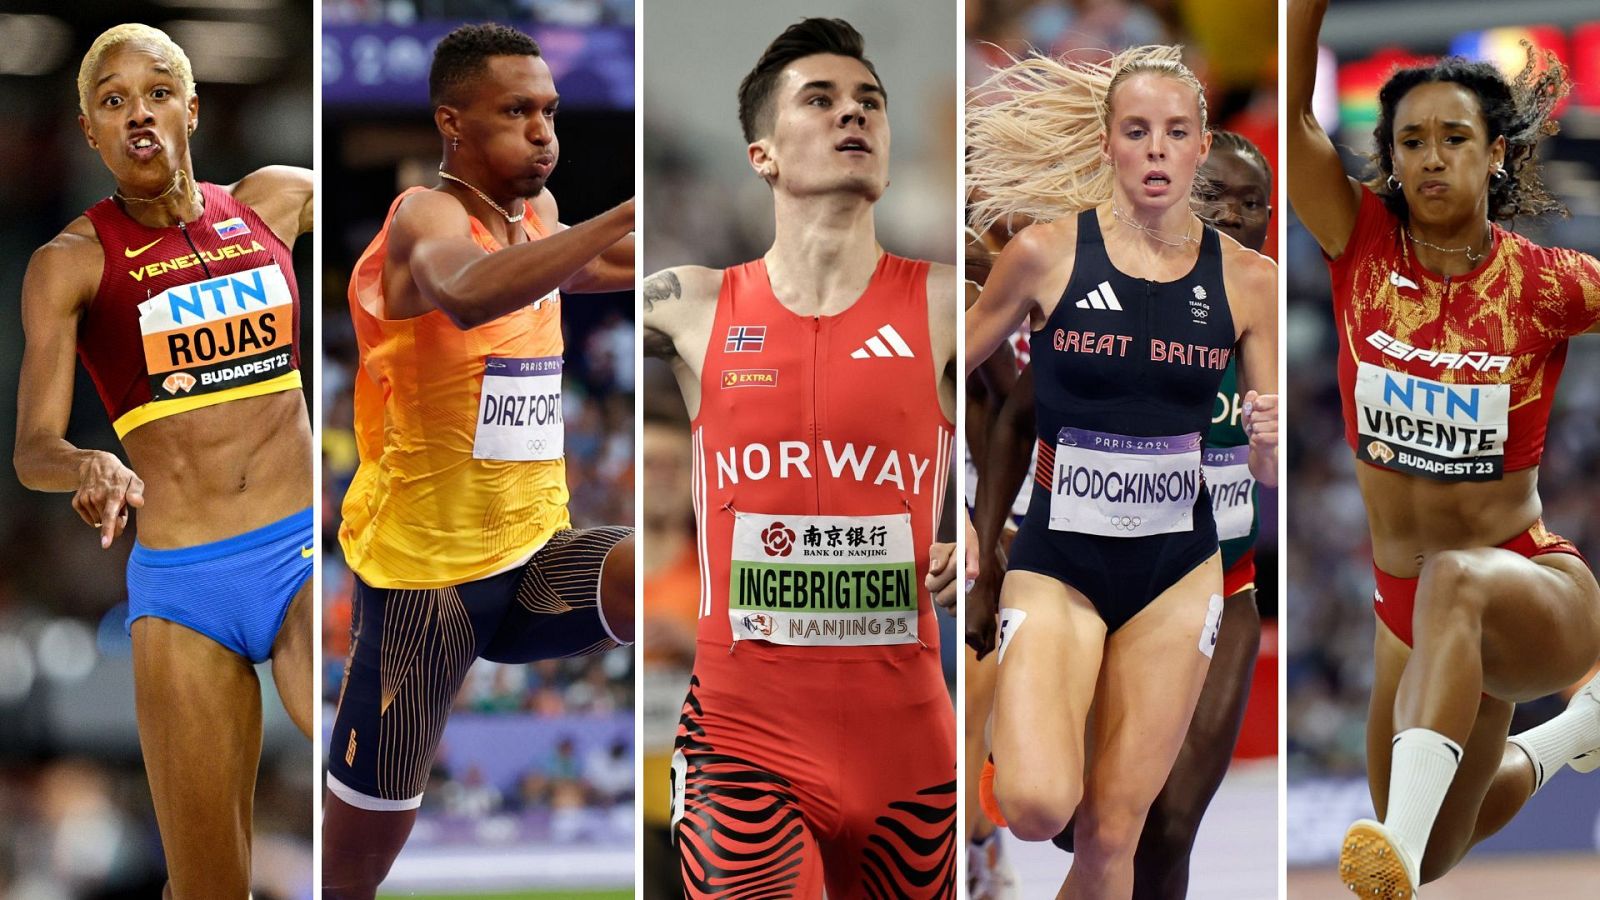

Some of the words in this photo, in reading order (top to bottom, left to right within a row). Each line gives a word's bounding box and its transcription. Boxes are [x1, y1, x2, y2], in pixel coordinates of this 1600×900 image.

[128, 240, 266, 282] VENEZUELA
[167, 271, 268, 325] NTN
[167, 312, 276, 367] ROJAS
[1053, 328, 1133, 357] GREAT
[1365, 329, 1512, 374] ESPAÑA
[200, 357, 275, 385] BUDAPEST
[275, 353, 289, 368] 23
[520, 361, 543, 371] PARIS
[739, 373, 773, 383] EXTRA
[482, 394, 526, 426] DIAZ
[528, 393, 562, 426] FORT
[1383, 373, 1479, 423] NTN
[1095, 436, 1132, 449] PARIS
[1137, 441, 1169, 450] 2024
[1363, 405, 1498, 455] VICENTE
[715, 439, 930, 495] NORWAY
[1207, 452, 1235, 462] 2024
[1398, 451, 1473, 475] BUDAPEST
[1475, 462, 1494, 474] 23
[1056, 464, 1196, 504] HODGKINSON
[803, 549, 830, 557] BANK
[833, 549, 844, 557] OF
[847, 549, 888, 557] NANJING
[739, 568, 911, 609] INGEBRIGTSEN
[789, 616, 881, 640] NANJING
[884, 617, 908, 634] 25
[345, 727, 357, 768] ESP
